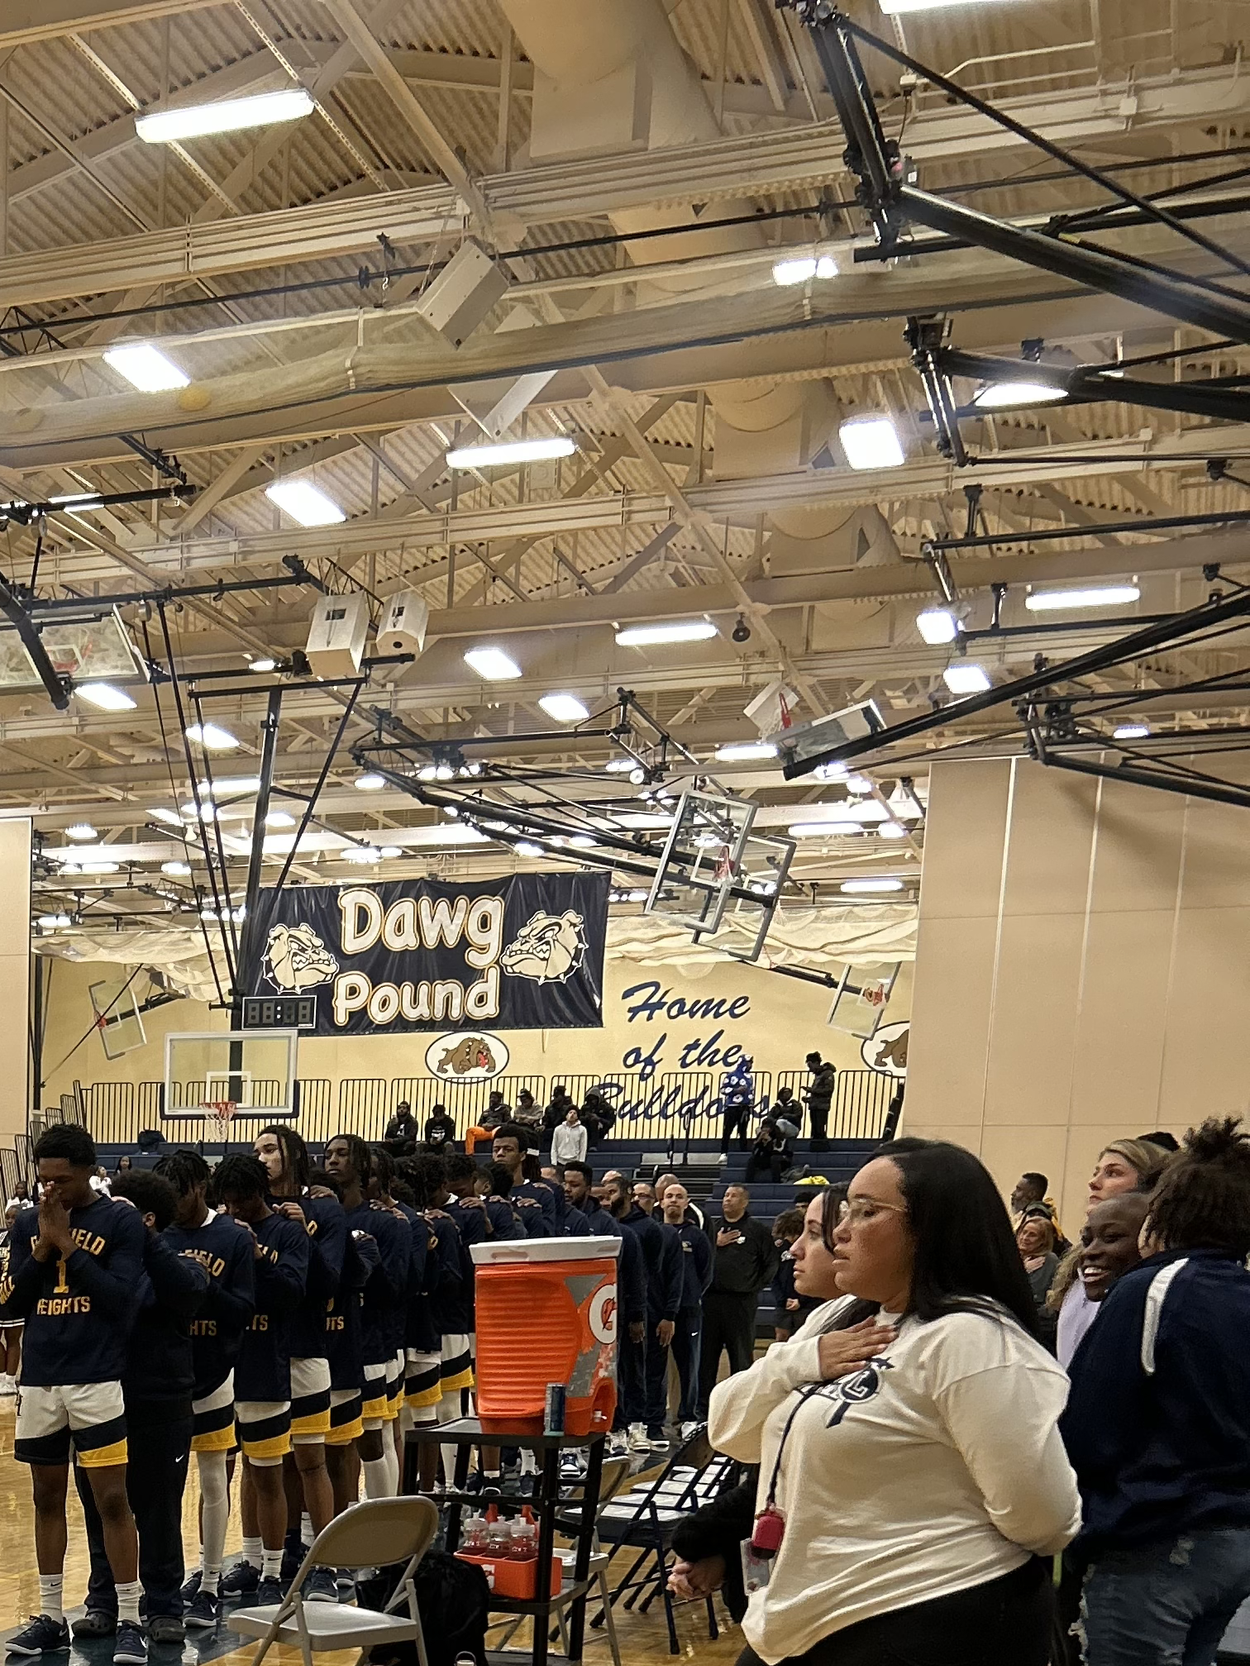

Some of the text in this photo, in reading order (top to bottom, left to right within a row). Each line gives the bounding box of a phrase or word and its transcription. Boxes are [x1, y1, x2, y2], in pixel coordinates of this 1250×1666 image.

[337, 887, 505, 970] Dawg
[332, 965, 500, 1027] Pound
[621, 980, 751, 1023] Home
[622, 1029, 743, 1082] of the
[598, 1082, 769, 1122] ulldos
[53, 1259, 69, 1294] 1
